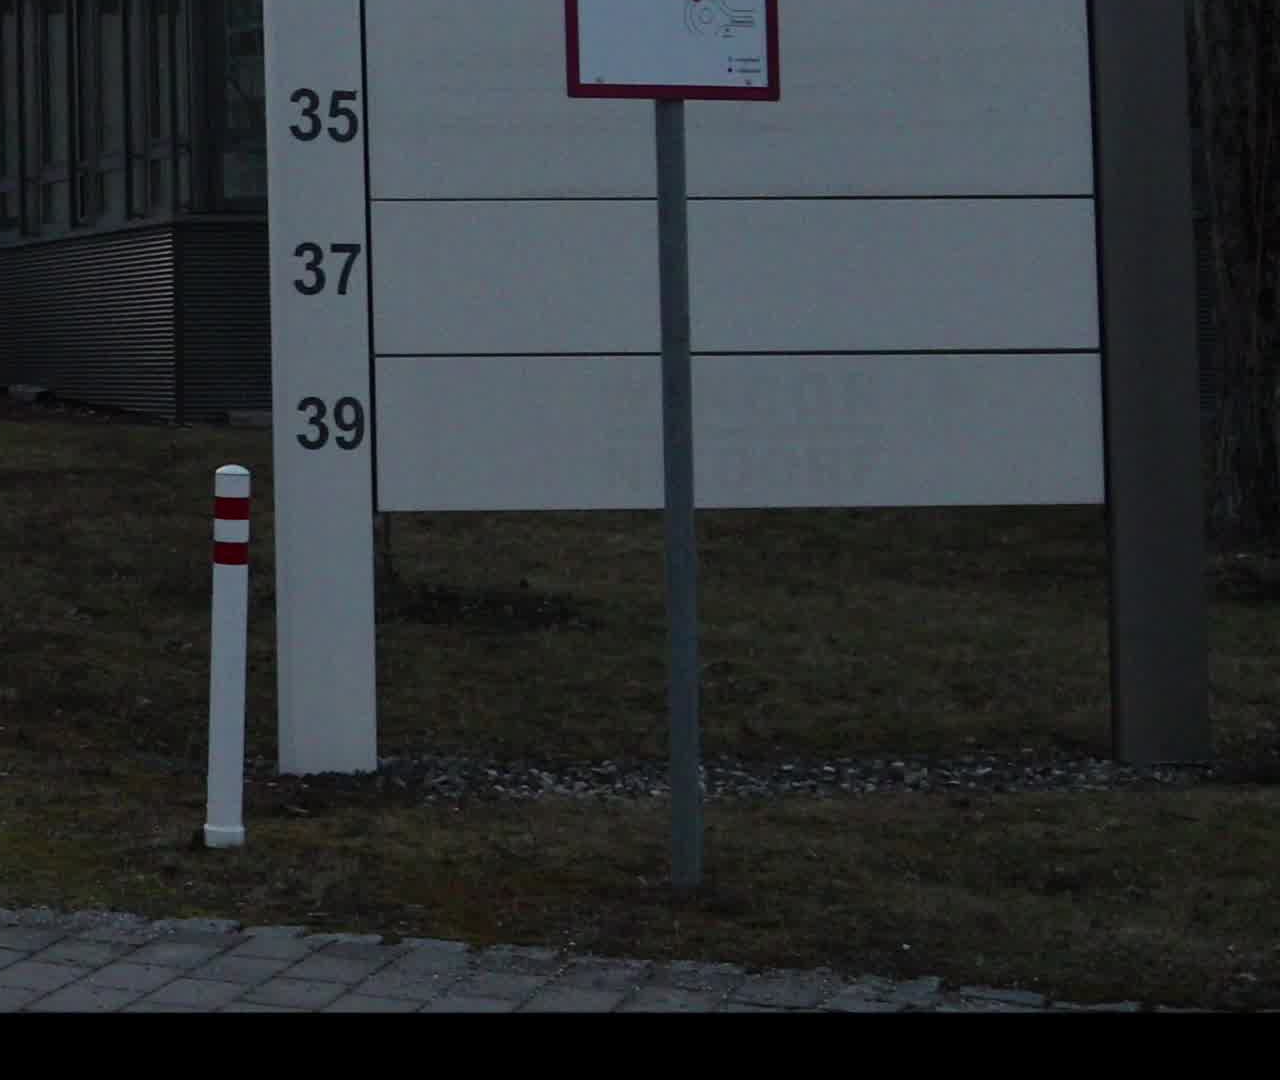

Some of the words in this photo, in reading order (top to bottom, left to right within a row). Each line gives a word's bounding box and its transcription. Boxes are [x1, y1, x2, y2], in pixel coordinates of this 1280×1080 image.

[289, 87, 359, 143] 35
[293, 241, 361, 296] 37
[295, 396, 365, 451] 39
